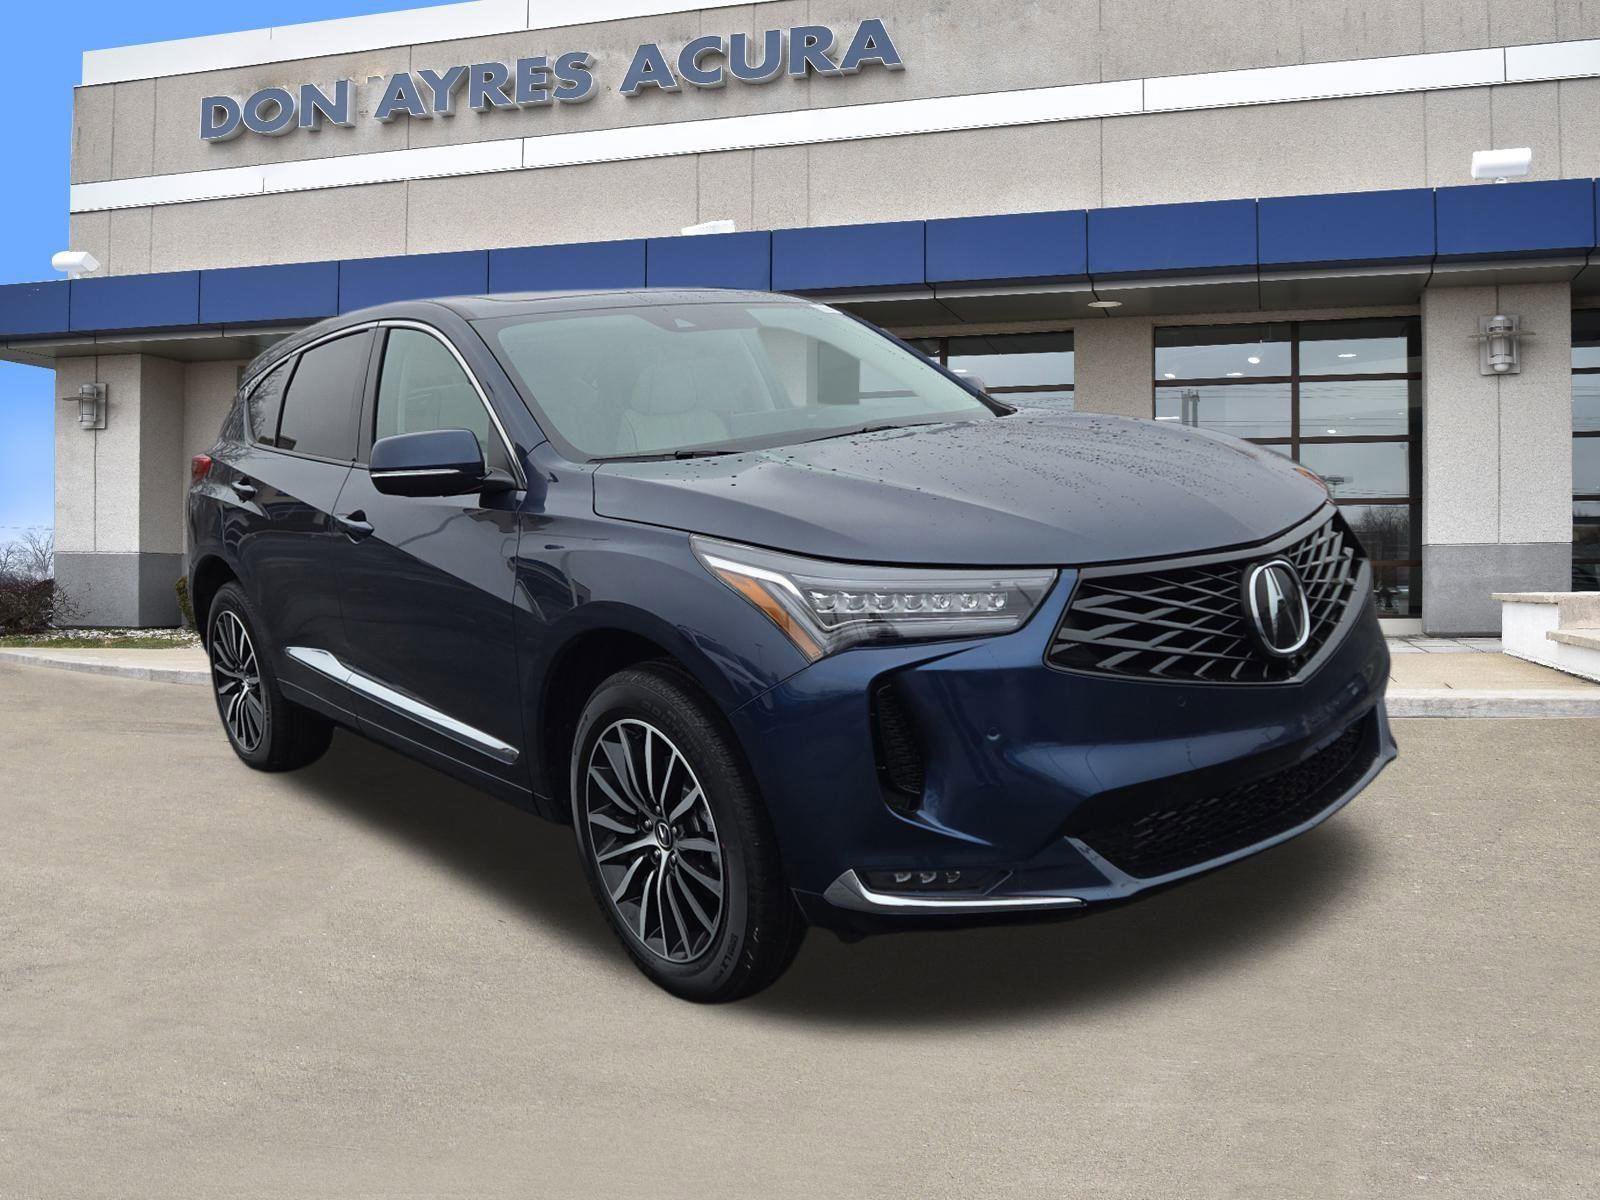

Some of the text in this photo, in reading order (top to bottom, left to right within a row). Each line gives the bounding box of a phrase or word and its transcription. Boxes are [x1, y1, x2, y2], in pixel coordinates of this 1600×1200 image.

[200, 18, 904, 141] DON AYRES ACURA
